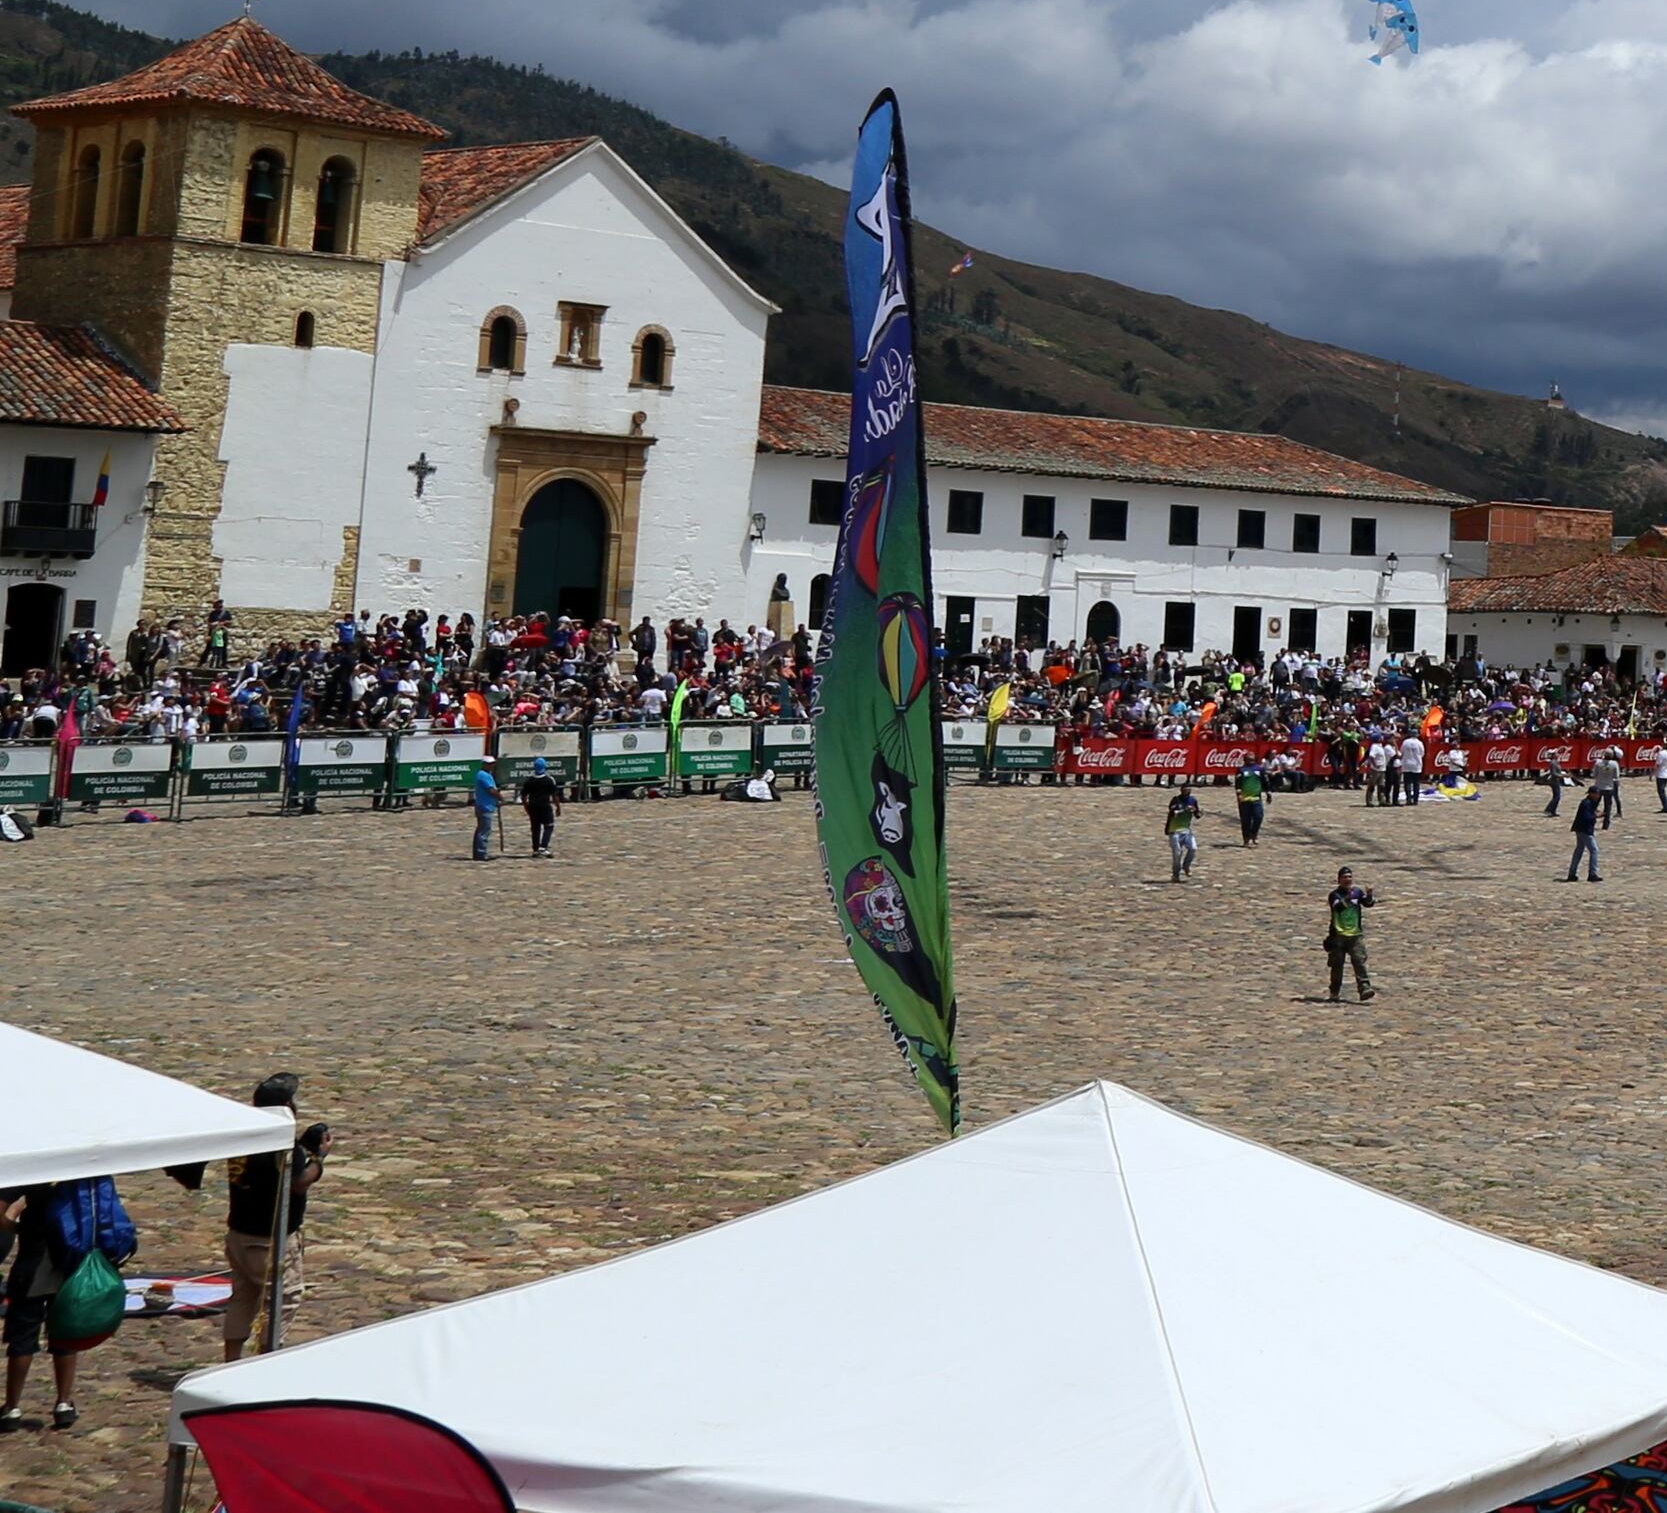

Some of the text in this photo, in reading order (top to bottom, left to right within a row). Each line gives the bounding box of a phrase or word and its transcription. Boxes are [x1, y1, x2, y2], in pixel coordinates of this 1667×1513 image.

[627, 756, 656, 765] NACIONAL
[713, 754, 739, 762] NACIONAL
[339, 767, 373, 776] NACIONAL
[437, 764, 470, 773] NACIONAL
[619, 765, 649, 774] COLOMBIA
[117, 774, 156, 784] NACIONAL
[232, 770, 267, 779] NACIONAL
[429, 774, 462, 782] COLOMBIA
[210, 781, 258, 789] DE COLOMBIA
[330, 777, 364, 785] COLOMBIA
[94, 785, 145, 794] DE COLOMBIA
